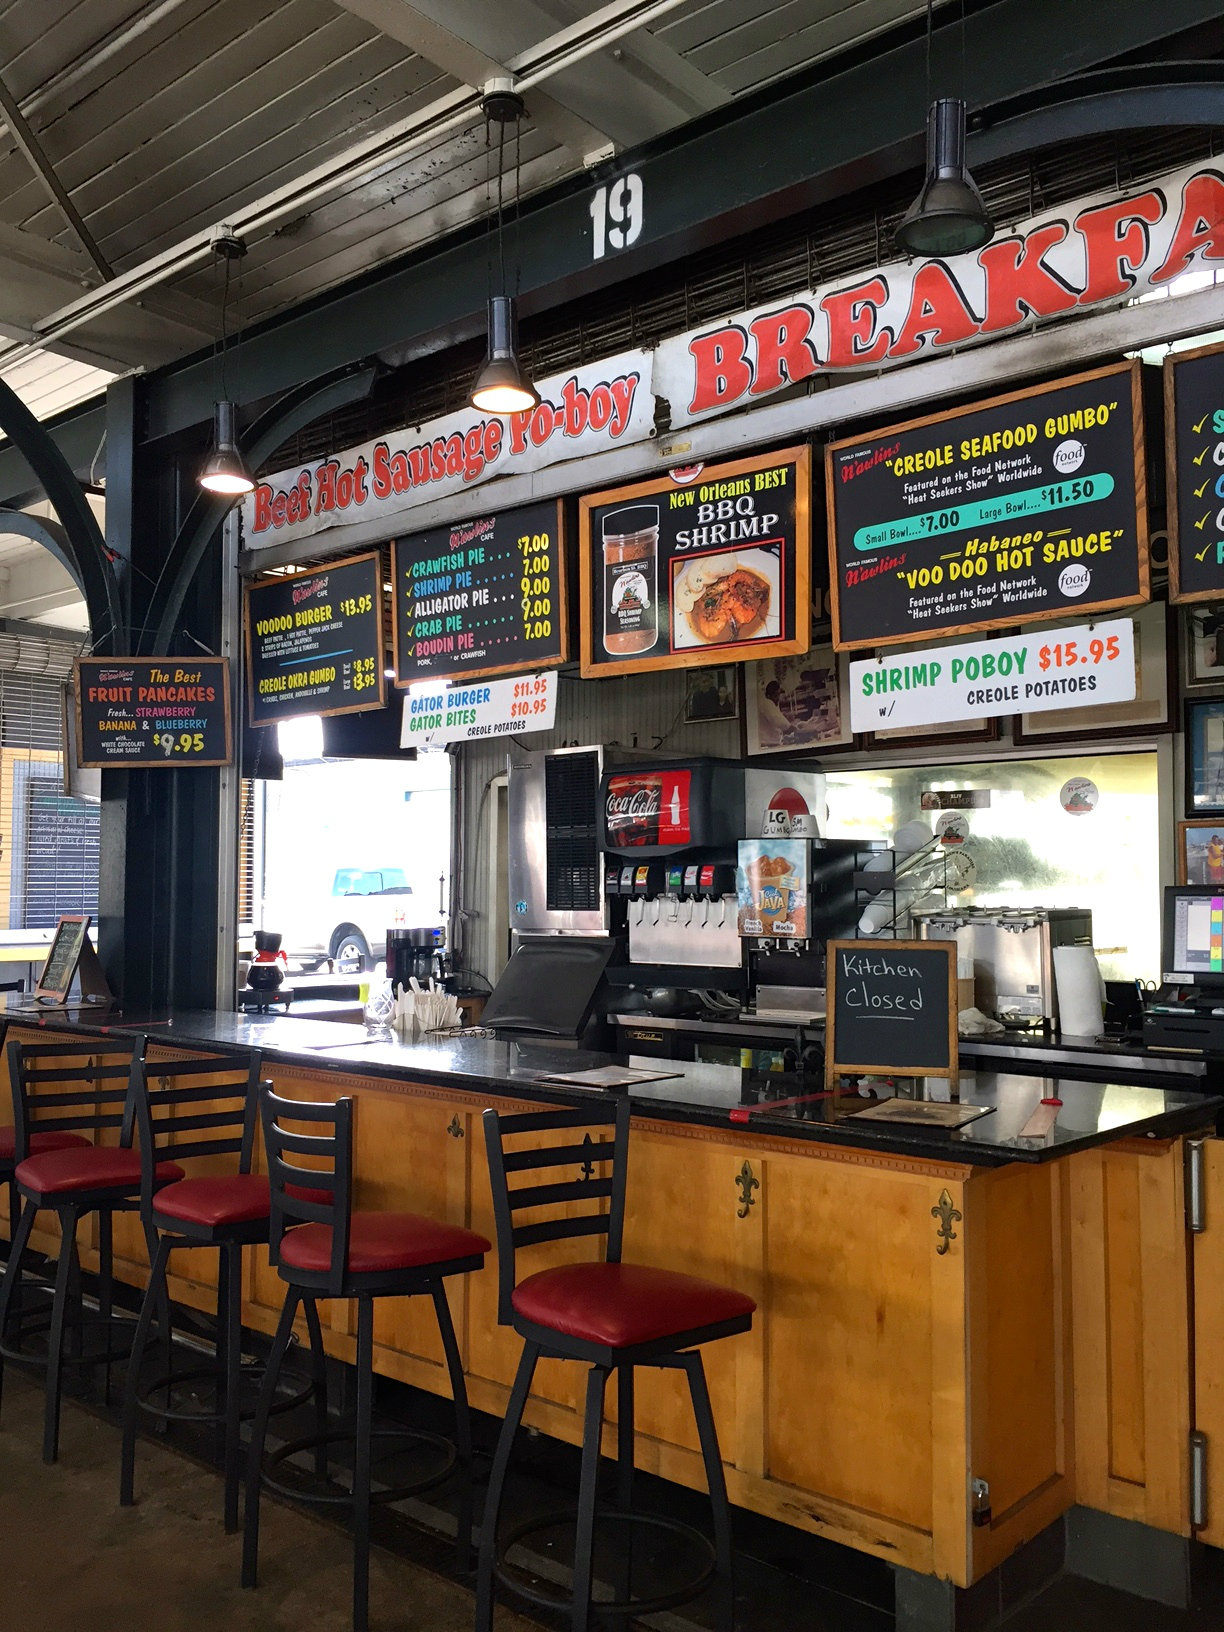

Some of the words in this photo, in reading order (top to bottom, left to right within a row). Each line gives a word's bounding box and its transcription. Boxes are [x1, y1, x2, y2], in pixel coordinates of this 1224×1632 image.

[588, 172, 644, 260] 19
[252, 472, 312, 535] Beef
[314, 456, 369, 516] Hot
[372, 419, 505, 500] Sausage
[510, 371, 640, 456] Po-boy
[960, 423, 1038, 461] SEAFOOD
[1055, 445, 1082, 467] food
[904, 477, 938, 493] Featured
[942, 476, 951, 484] on
[955, 470, 968, 481] the
[972, 464, 991, 476] Food
[995, 454, 1031, 471] Network
[930, 485, 962, 500] Seekers
[997, 465, 1042, 483] Worldwide
[669, 490, 695, 510] New
[699, 476, 750, 503] Orleans
[754, 467, 788, 491] BEST
[697, 495, 756, 525] BBQ
[865, 531, 887, 544] Small
[920, 510, 959, 533] $7.00
[980, 507, 1002, 520] Large
[1041, 479, 1094, 506] $11.50
[481, 532, 494, 541] CAFE
[674, 512, 780, 551] SHRIMP
[965, 530, 1043, 557] Habaneo
[412, 551, 464, 578] CRAWFISH
[468, 547, 485, 565] PIE
[517, 533, 550, 557] $7.00
[949, 556, 988, 581] DOO
[996, 547, 1034, 572] HOT
[414, 578, 452, 598] SHRIMP
[455, 571, 472, 588] PIE
[523, 555, 550, 576] 7.00
[1061, 570, 1088, 589] food
[317, 590, 328, 598] CAFE
[415, 593, 468, 618] ALLIGATOR
[472, 589, 489, 607] PIE
[521, 577, 550, 599] 9.00
[909, 593, 943, 608] Featured
[947, 593, 957, 601] on
[960, 587, 974, 598] the
[977, 583, 996, 595] Food
[1000, 576, 1037, 592] Network
[935, 602, 967, 615] Seekers
[1002, 588, 1048, 603] Worldwide
[257, 614, 293, 636] VOODOO
[295, 605, 332, 627] BURGER
[340, 594, 373, 617] $13.95
[415, 621, 442, 638] CRAB
[446, 615, 462, 632] PIE
[416, 637, 454, 657] BOUDIN
[457, 633, 474, 650] PIE
[524, 620, 551, 640] 7.00
[353, 656, 375, 672] $8.95
[417, 659, 432, 667] PORK,
[461, 649, 486, 660] CRAWFISH
[861, 662, 942, 697] SHRIMP
[951, 647, 1028, 684] POBOY
[1038, 635, 1121, 672] $15.95
[150, 669, 169, 683] The
[174, 669, 202, 684] Best
[259, 676, 286, 694] CREOLE
[288, 672, 308, 689] OKRA
[309, 666, 336, 685] GUMBO
[353, 672, 376, 691] 13.95
[88, 687, 133, 702] FRUIT
[138, 687, 215, 702] PANCAKES
[411, 694, 443, 714] GATOR
[448, 687, 491, 708] BURGER
[513, 679, 547, 699] $11.95
[879, 700, 896, 717] w/
[967, 685, 1019, 705] CREOLE
[1025, 675, 1097, 699] POTATOES
[98, 721, 137, 731] BANANA
[142, 720, 150, 730] &
[155, 719, 208, 730] BLUEBERRY
[135, 707, 196, 717] STRAWBERRY
[409, 714, 442, 732] GATOR
[446, 708, 477, 726] BITES
[511, 698, 547, 719] $10.95
[467, 725, 492, 737] CREOLE
[493, 720, 526, 734] POTATOES
[153, 733, 205, 757] $9.95
[606, 789, 660, 817] Coca-Cola
[769, 812, 786, 824] LG
[755, 889, 785, 910] JAVA
[843, 954, 922, 978] Kitchen
[845, 981, 923, 1010] Closed
